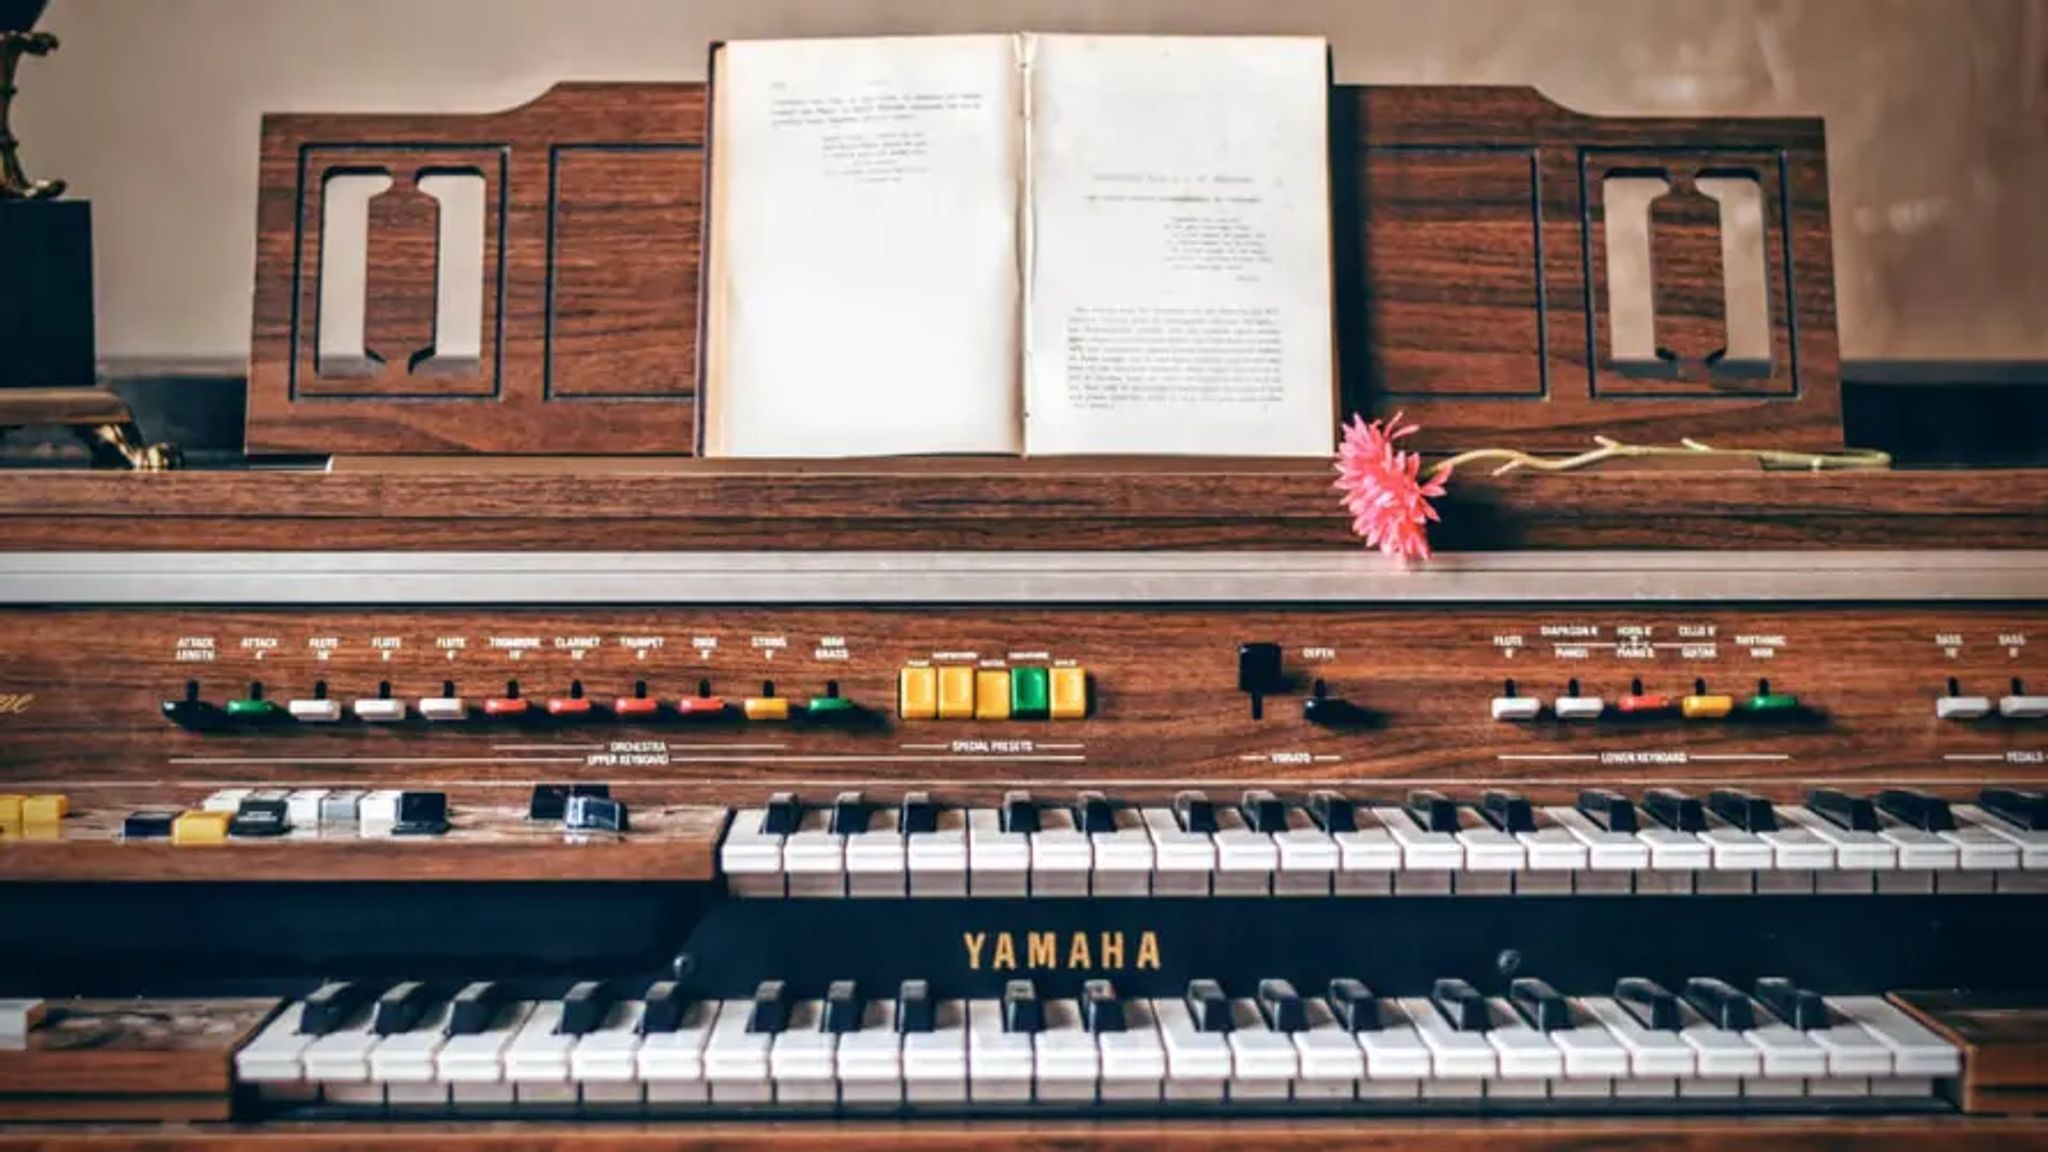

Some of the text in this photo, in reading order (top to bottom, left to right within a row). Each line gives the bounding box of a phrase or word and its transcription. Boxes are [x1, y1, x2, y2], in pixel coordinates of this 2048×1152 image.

[610, 741, 667, 752] ORCHESTRA
[953, 741, 1033, 752] SPECIAL PRESETS
[587, 754, 669, 766] UPPER KEYBOARD
[1601, 752, 1687, 764] LOWER KEYBOARD
[963, 931, 1162, 970] YAMAHA
